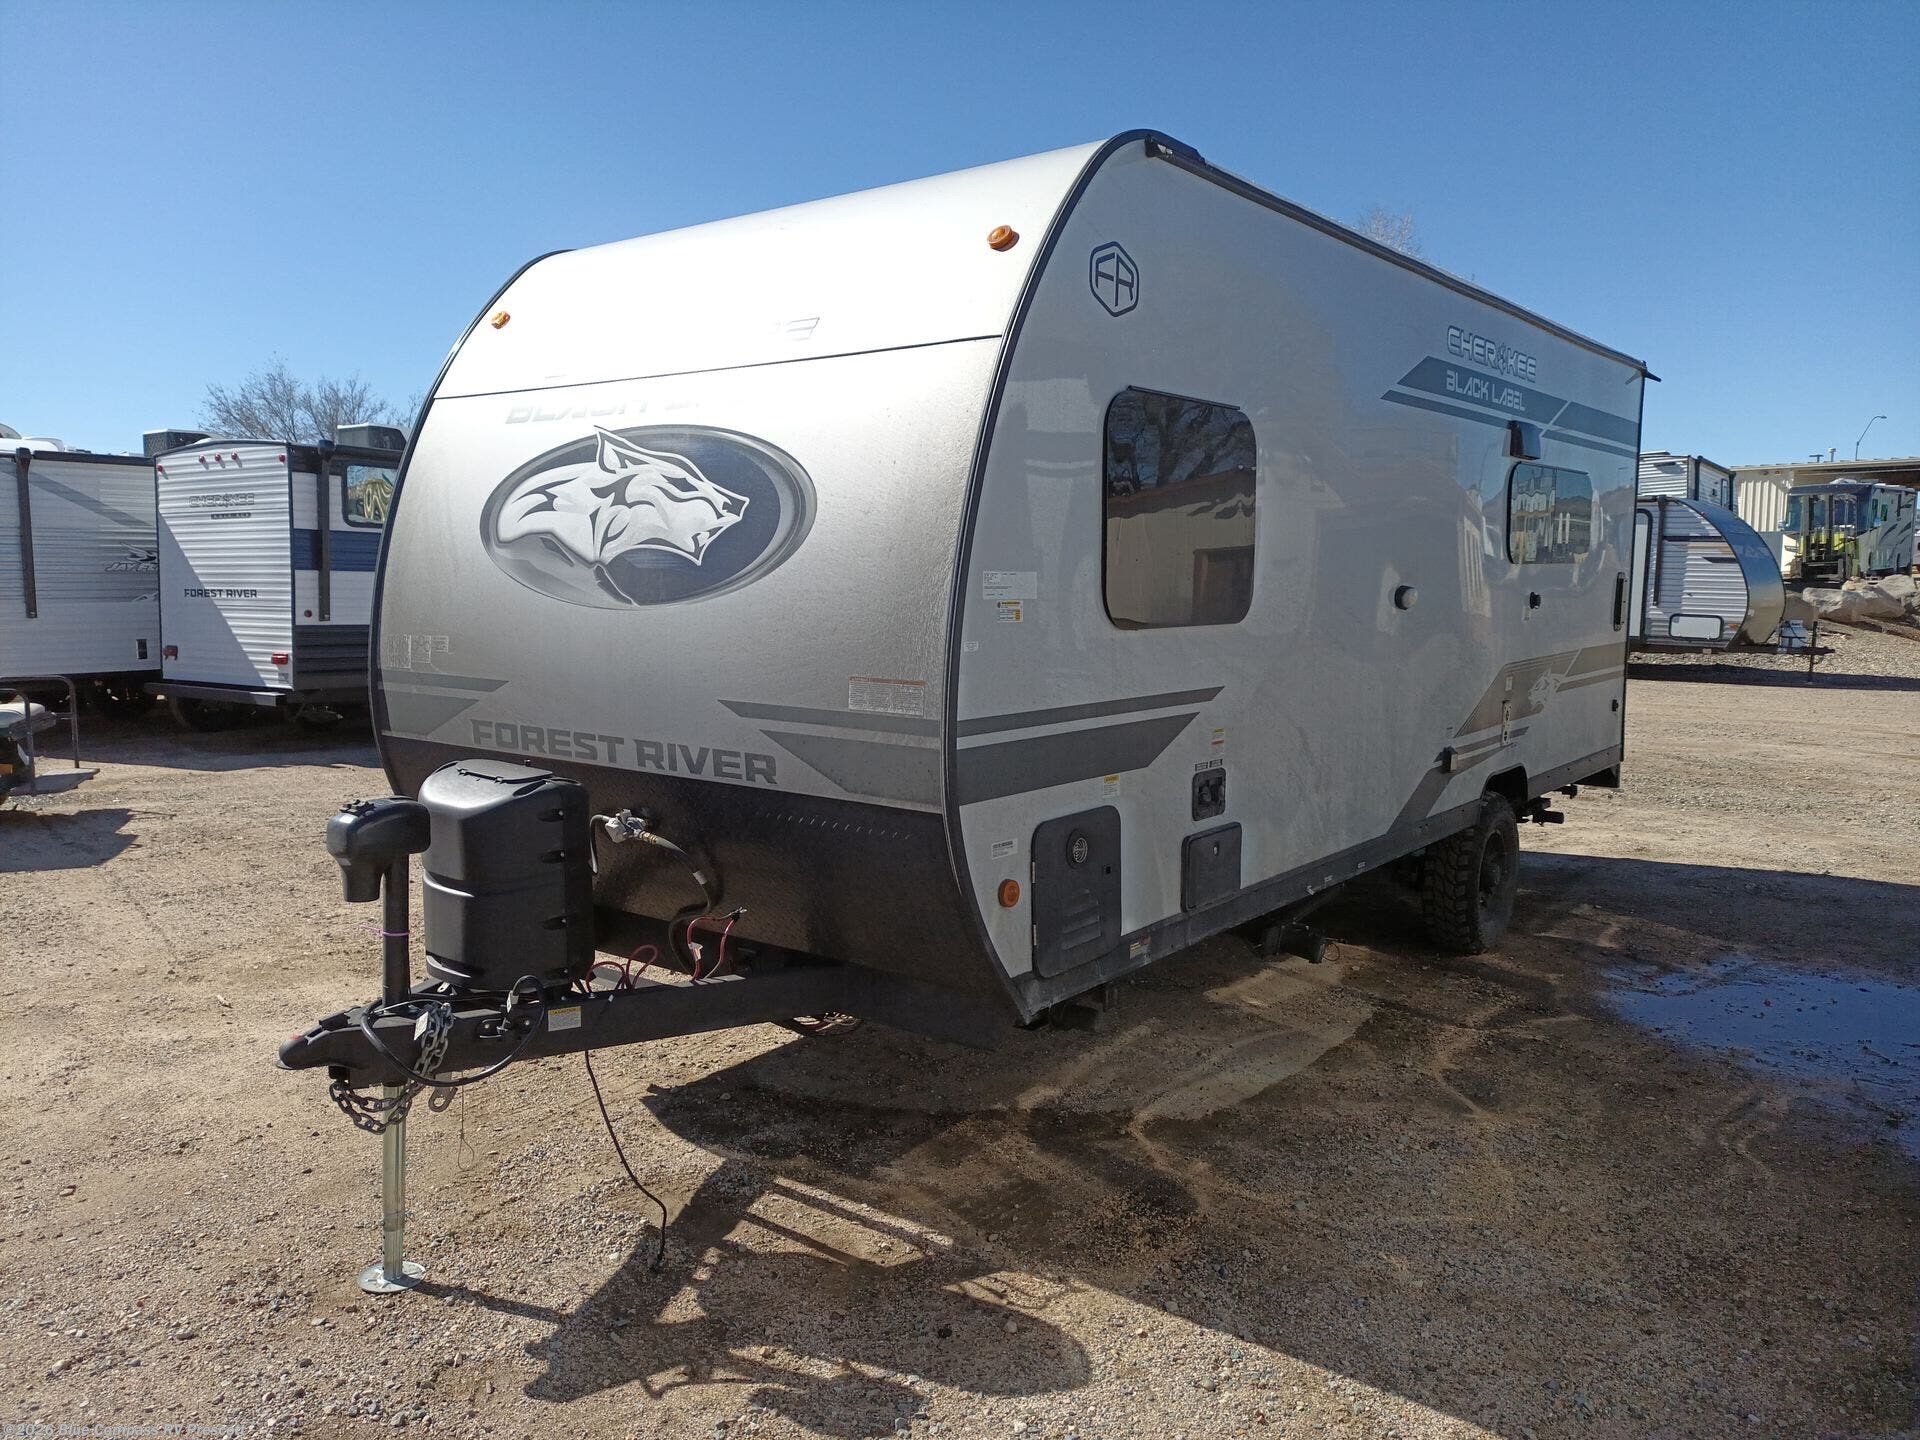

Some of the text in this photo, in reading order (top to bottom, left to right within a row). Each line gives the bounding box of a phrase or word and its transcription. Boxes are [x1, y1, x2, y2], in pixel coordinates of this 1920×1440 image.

[1446, 370, 1526, 412] BLACK LABEL
[184, 588, 258, 598] FOREST RIVER
[469, 719, 778, 785] FOREST RIVER
